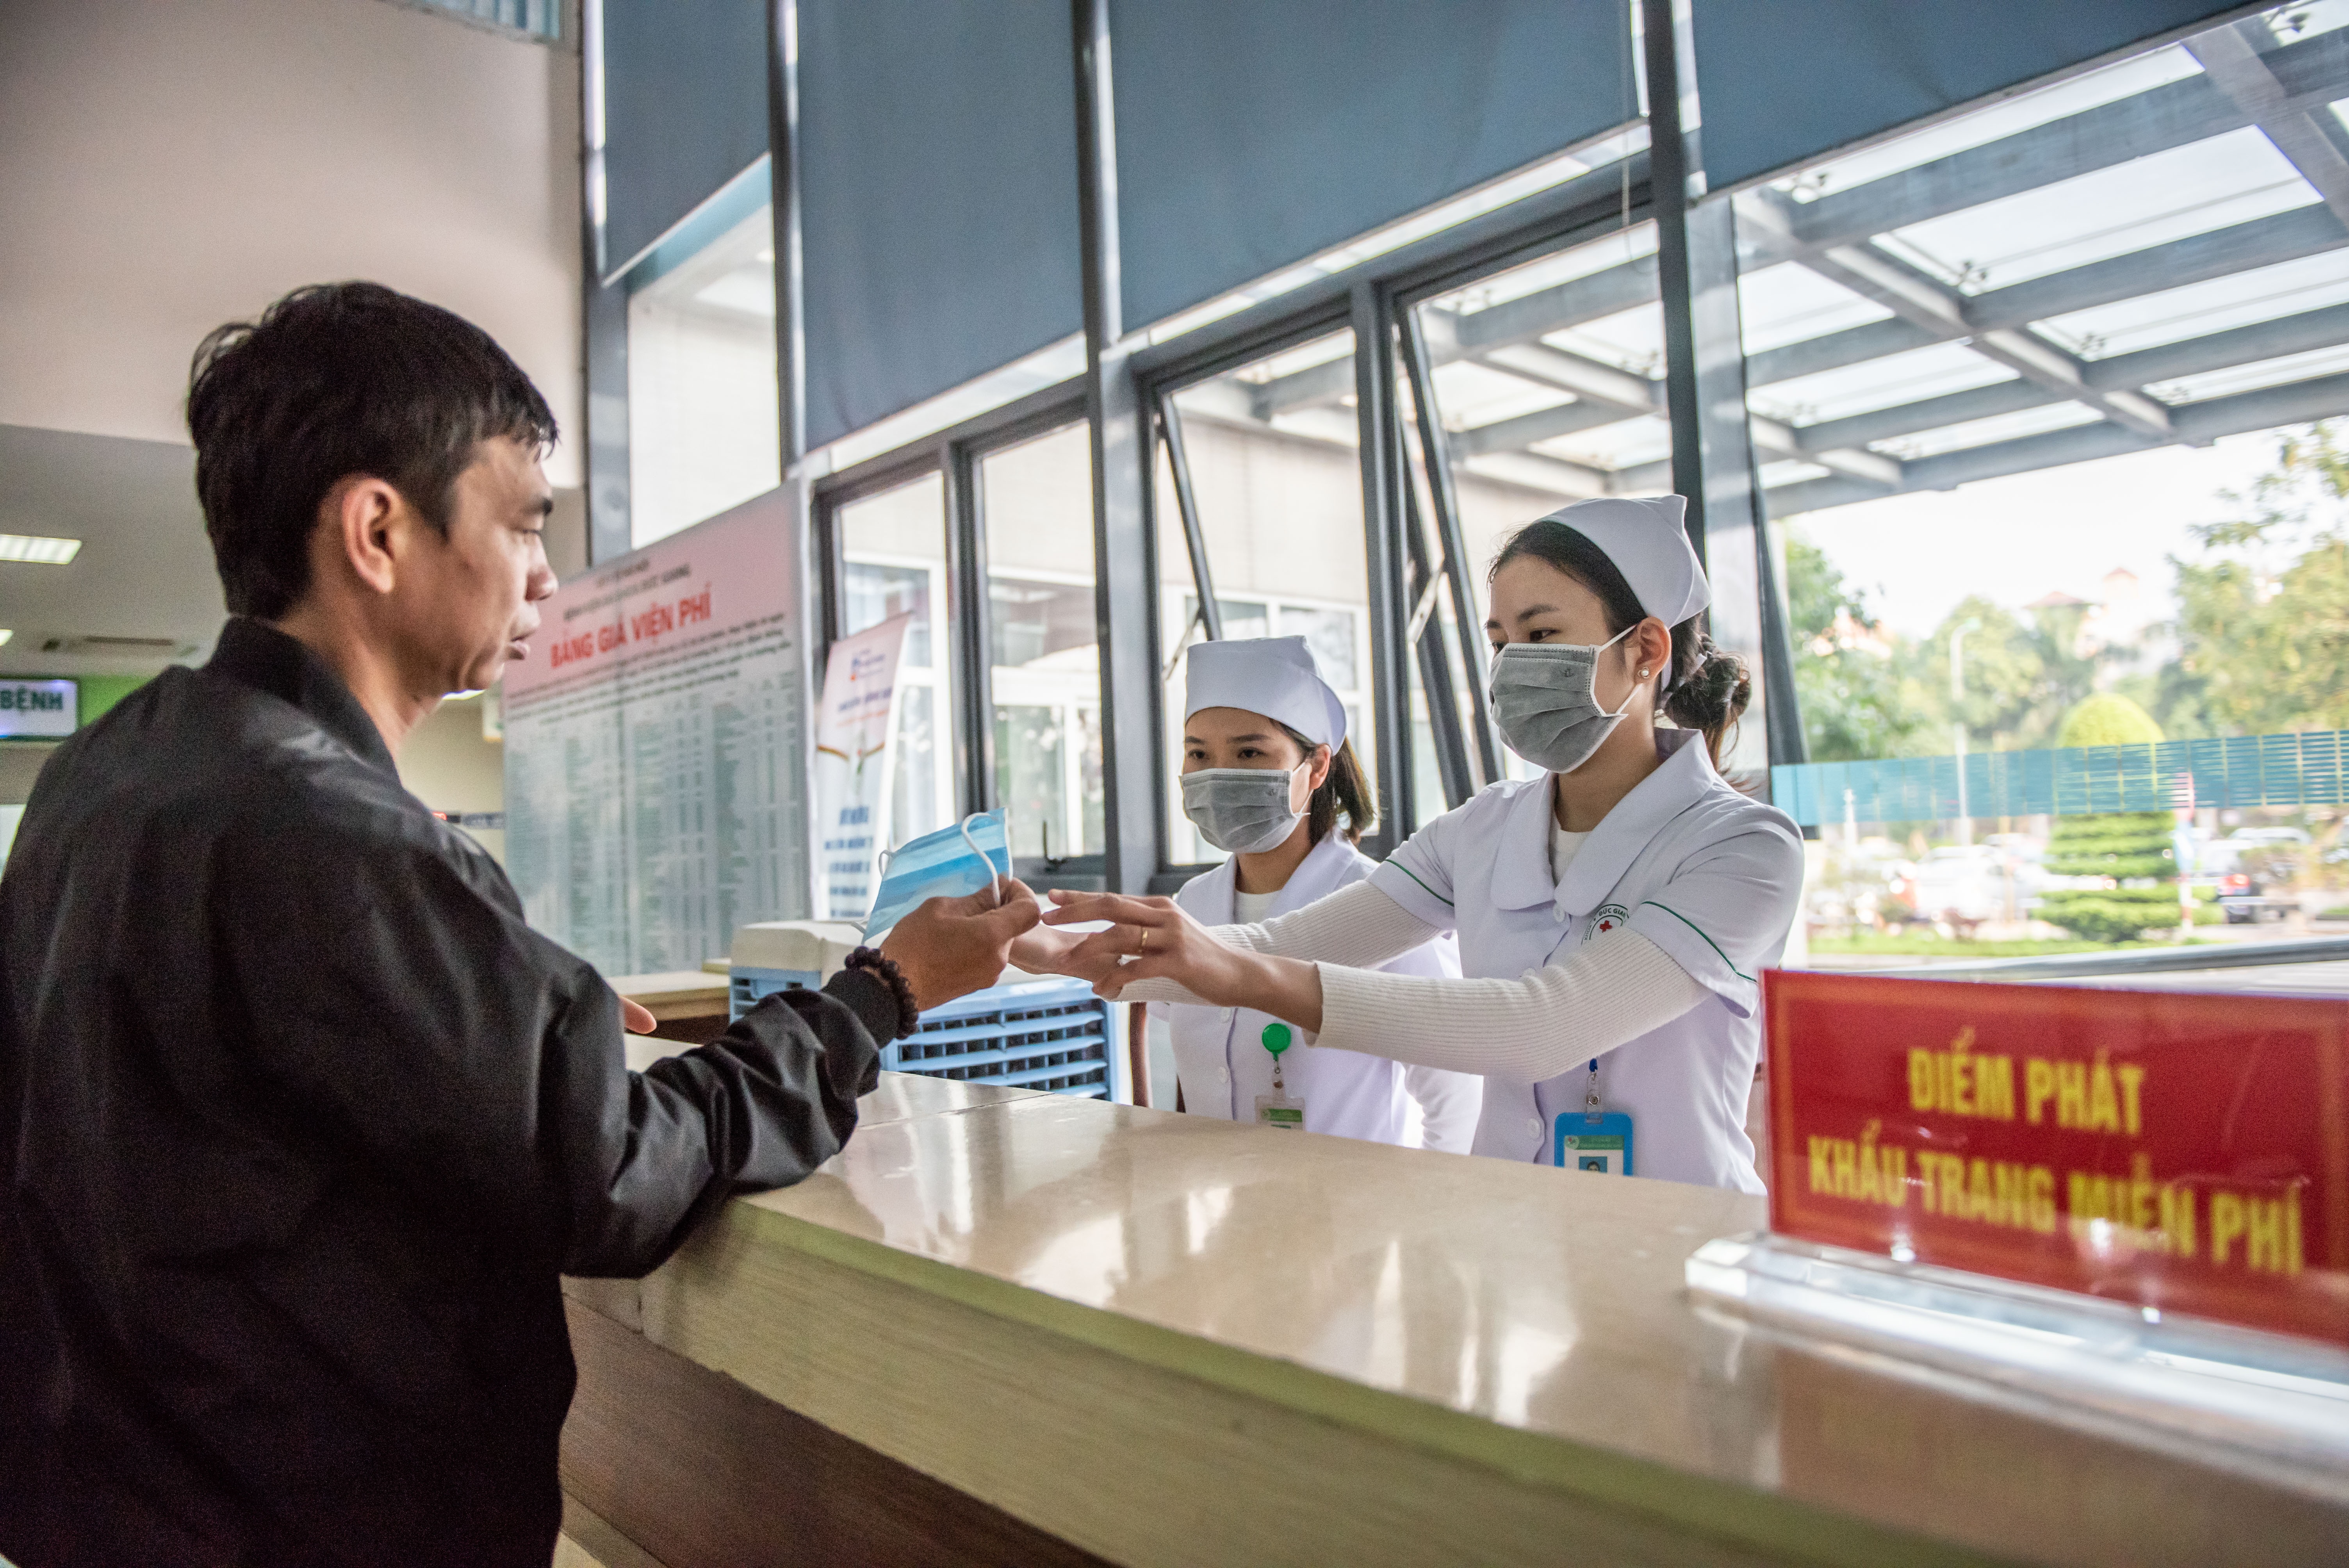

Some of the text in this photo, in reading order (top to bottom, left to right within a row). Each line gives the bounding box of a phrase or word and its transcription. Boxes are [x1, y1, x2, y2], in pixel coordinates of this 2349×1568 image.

[1909, 1025, 2144, 1136] ĐIỂM PHÁT
[1809, 1118, 1907, 1207] KHẨU
[1916, 1151, 2057, 1235] TRANG
[2211, 1177, 2304, 1276] PHÍ
